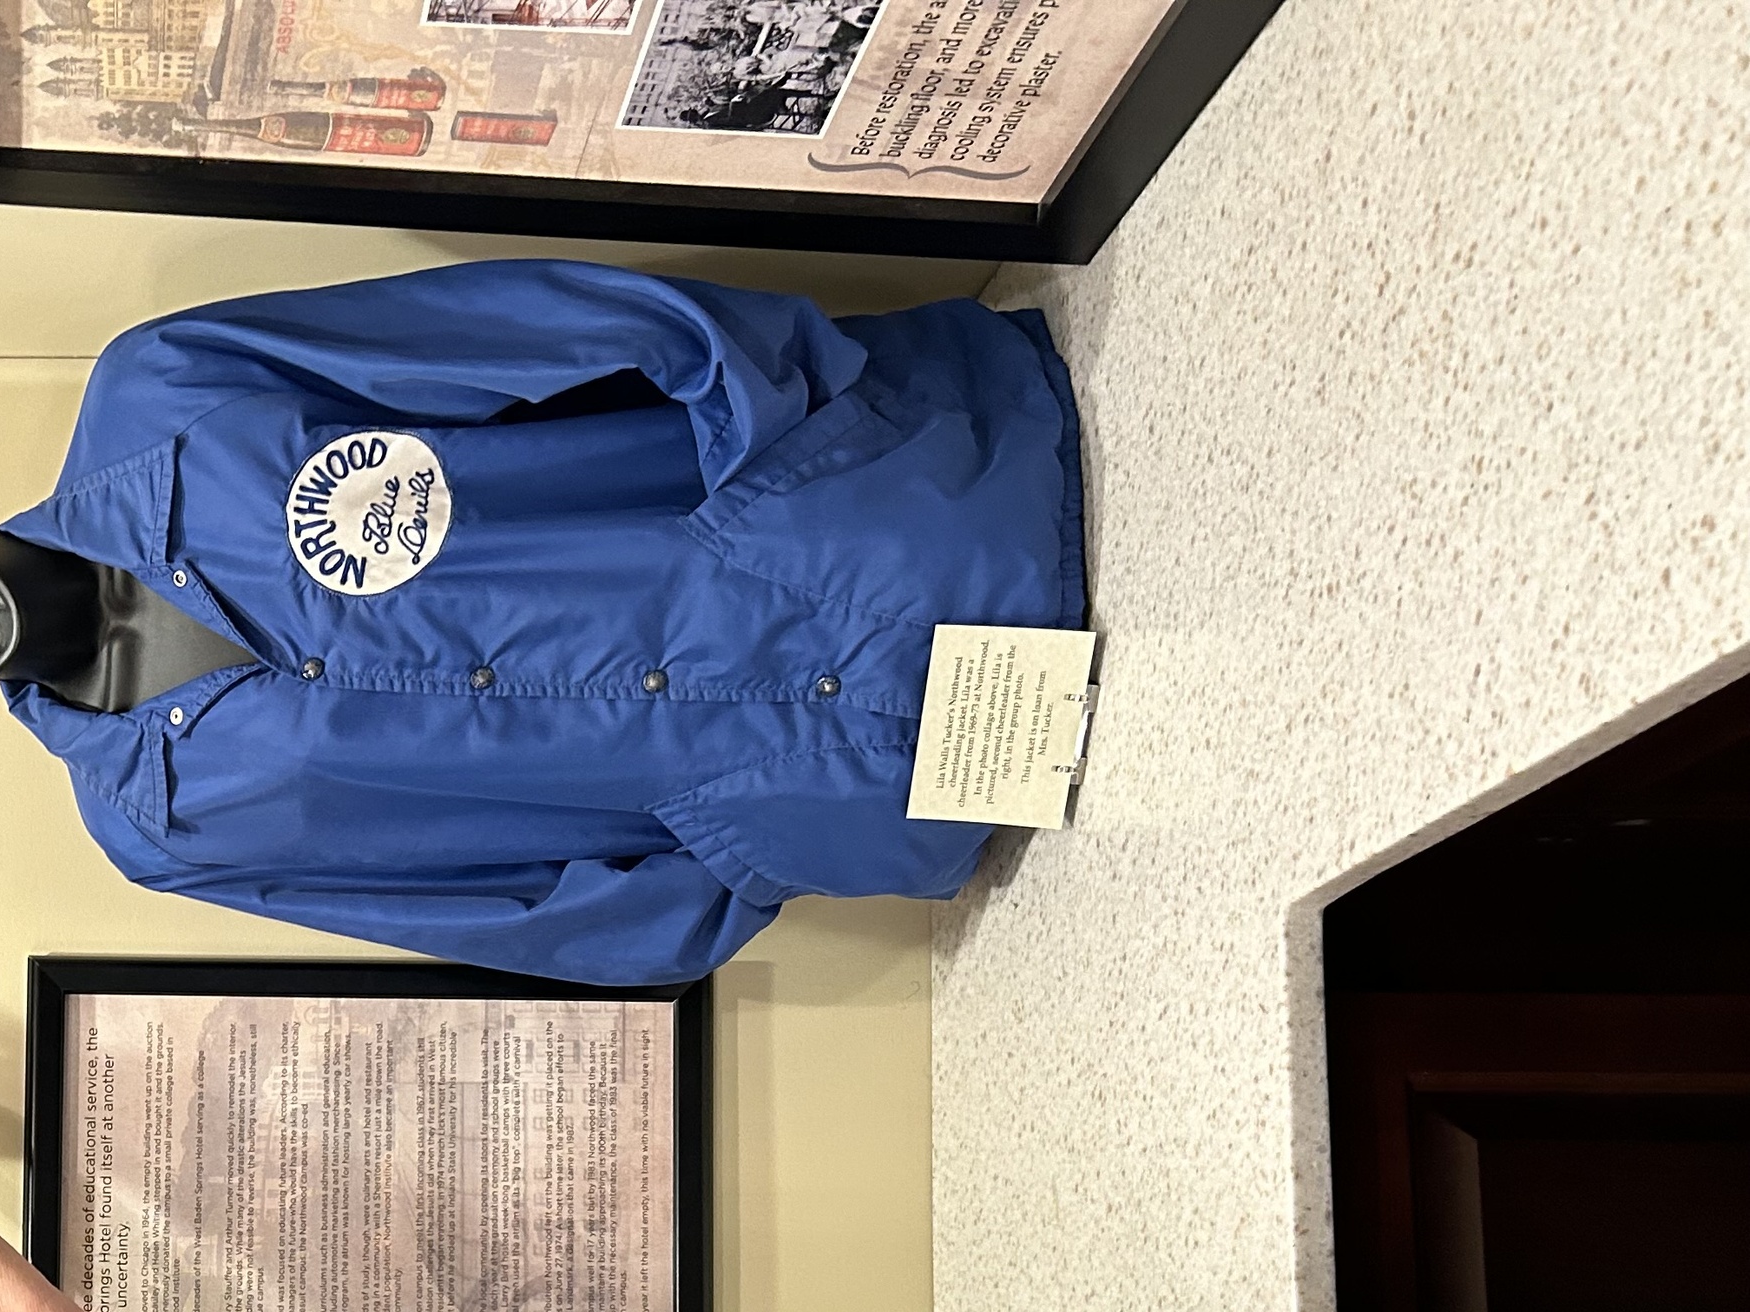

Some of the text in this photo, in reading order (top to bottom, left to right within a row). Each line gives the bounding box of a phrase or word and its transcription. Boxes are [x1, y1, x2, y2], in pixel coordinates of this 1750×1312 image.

[850, 117, 886, 156] Before
[877, 40, 929, 114] restoration,
[916, 12, 941, 35] the
[880, 0, 982, 158] buckling floor, and more
[951, 116, 993, 161] cooling
[979, 68, 1015, 113] system
[1007, 12, 1048, 64] ensures
[912, 101, 961, 160] diagnosis
[947, 79, 974, 98] led
[963, 60, 984, 75] to
[976, 51, 1061, 163] decorative plaster.
[293, 438, 388, 589] NORTHWOOD
[362, 476, 399, 555] Blue
[397, 468, 435, 565] Devils
[973, 640, 989, 692] Northwood.
[993, 653, 1003, 661] is
[964, 667, 973, 683] was
[990, 663, 1001, 680] Lila
[959, 685, 970, 702] Lila
[973, 694, 981, 702] at
[1012, 673, 1024, 701] photo.
[935, 657, 962, 789] Lila Walls Tucker's Northwood
[955, 704, 968, 732] jacket.
[982, 712, 996, 742] collage
[985, 645, 1016, 804] pictured, second cheerleader from the
[1009, 702, 1022, 729] group
[1020, 671, 1046, 784] This jacket is on loan from
[963, 737, 975, 758] from
[1003, 746, 1013, 755] in
[1005, 730, 1015, 744] the
[1037, 737, 1048, 756] Mrs.
[947, 734, 965, 787] cheerleading
[978, 744, 989, 769] photo
[956, 759, 971, 808] cheerleader
[973, 786, 983, 795] In
[975, 771, 985, 784] the
[84, 1028, 97, 1052] the
[640, 1053, 649, 1061] in
[84, 1057, 98, 1112] service,
[101, 1054, 114, 1112] another
[639, 1063, 649, 1090] future
[639, 1091, 648, 1118] viable
[102, 1116, 113, 1131] at
[641, 1119, 648, 1132] no
[100, 1135, 113, 1171] itself
[639, 1134, 648, 1153] with
[82, 1117, 96, 1203] educational
[639, 1155, 648, 1175] time
[99, 1176, 112, 1219] found
[639, 1177, 648, 1193] this
[81, 1208, 94, 1223] of
[98, 1224, 111, 1263] Hotel
[639, 1227, 648, 1249] hotel
[80, 1224, 94, 1290] decades
[115, 1222, 130, 1308] uncertainty.
[639, 1251, 648, 1266] the
[639, 1268, 648, 1283] left
[641, 1294, 649, 1312] year
